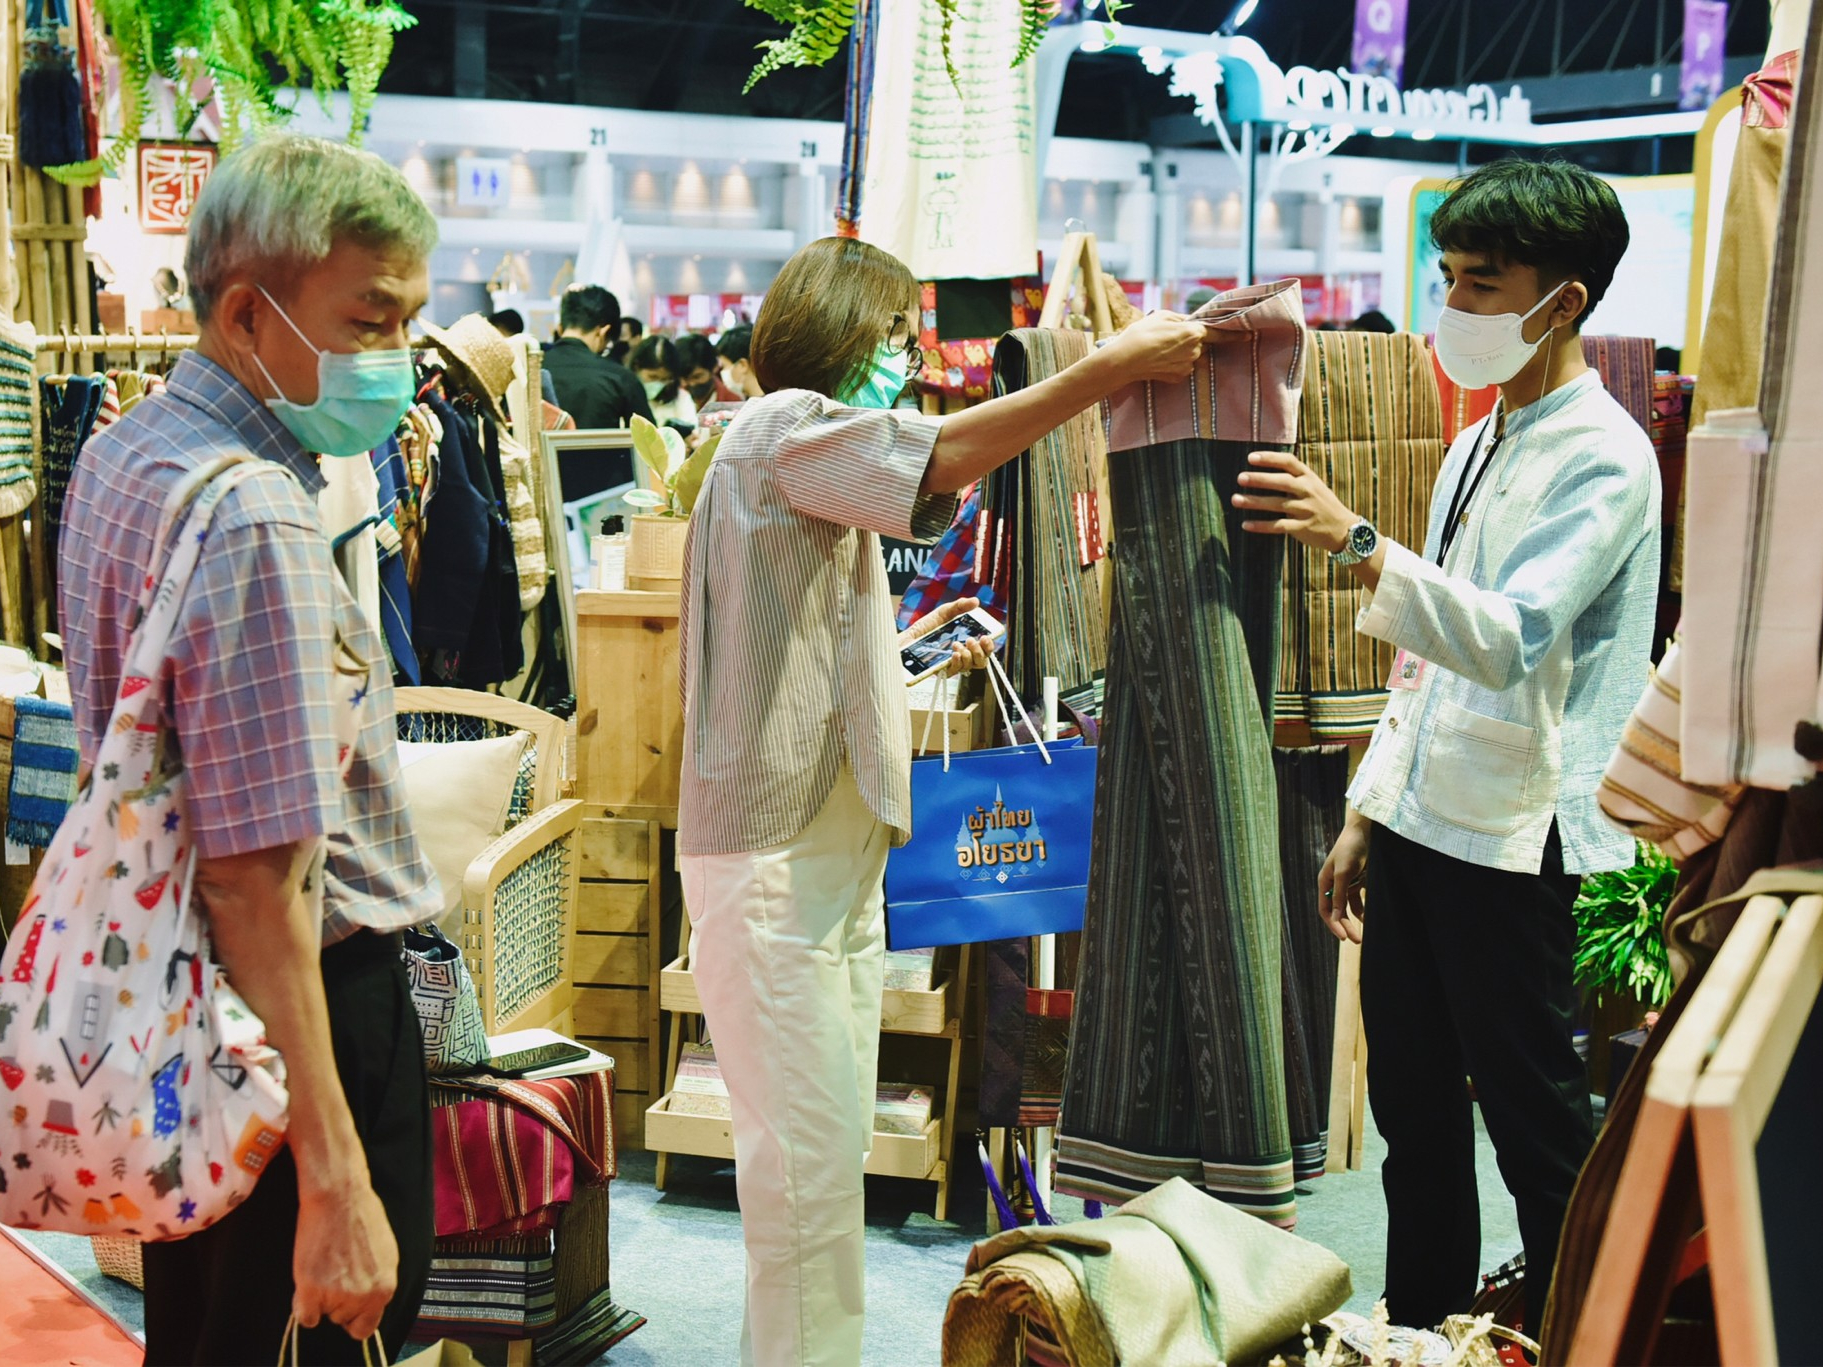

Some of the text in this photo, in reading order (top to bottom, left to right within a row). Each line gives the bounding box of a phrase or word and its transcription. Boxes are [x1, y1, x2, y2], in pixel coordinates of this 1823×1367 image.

[1367, 0, 1393, 34] Q
[589, 127, 607, 146] 21
[967, 801, 1031, 830] ผ้าไทย
[956, 831, 1047, 868] อโยธยา
